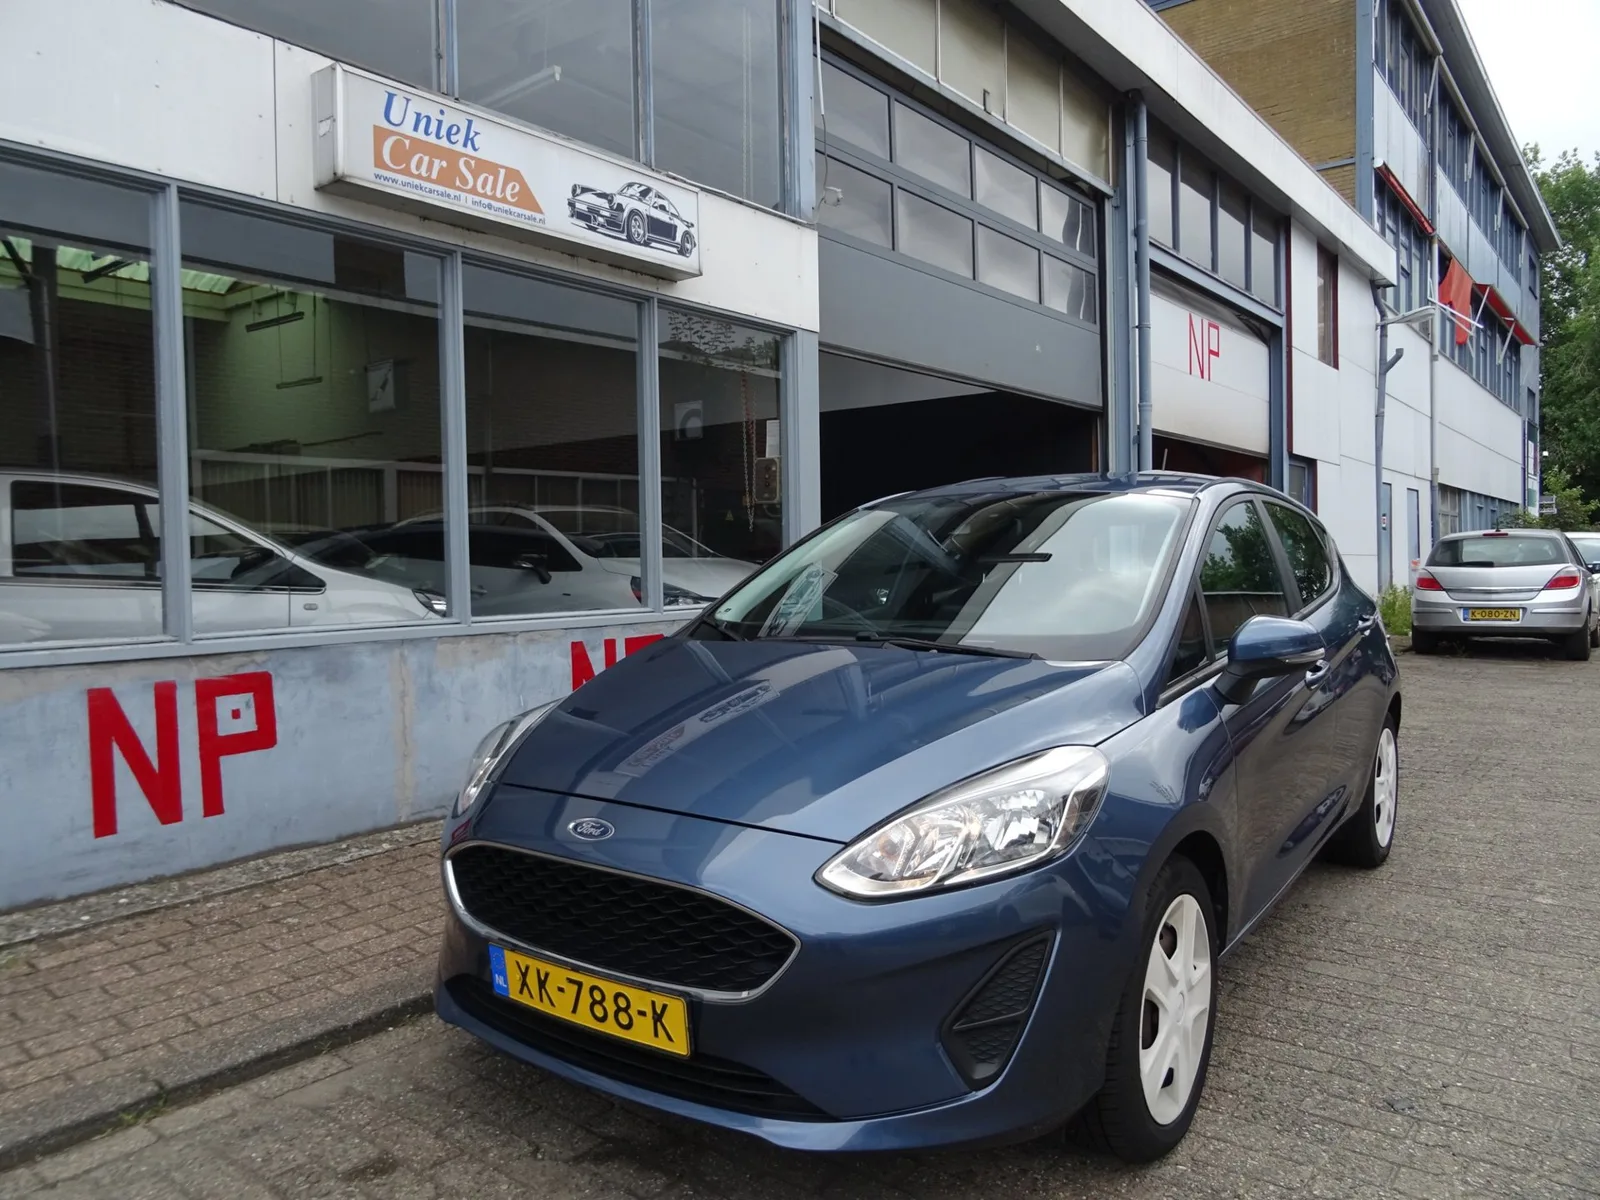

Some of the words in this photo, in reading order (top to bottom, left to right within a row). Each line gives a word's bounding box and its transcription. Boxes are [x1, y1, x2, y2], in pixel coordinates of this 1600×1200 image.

[383, 91, 481, 151] Uniek
[373, 172, 462, 203] www.uniekcarsale.nl
[471, 198, 547, 226] info@uniekcarsale.nl
[381, 135, 448, 181] Car
[455, 157, 521, 203] Sale
[1188, 312, 1220, 382] NP
[1470, 610, 1516, 618] K-080-ZN
[570, 633, 665, 693] N
[86, 670, 278, 840] NP
[576, 820, 605, 837] Ford
[494, 973, 508, 989] NL
[515, 960, 674, 1043] XK-788-K
